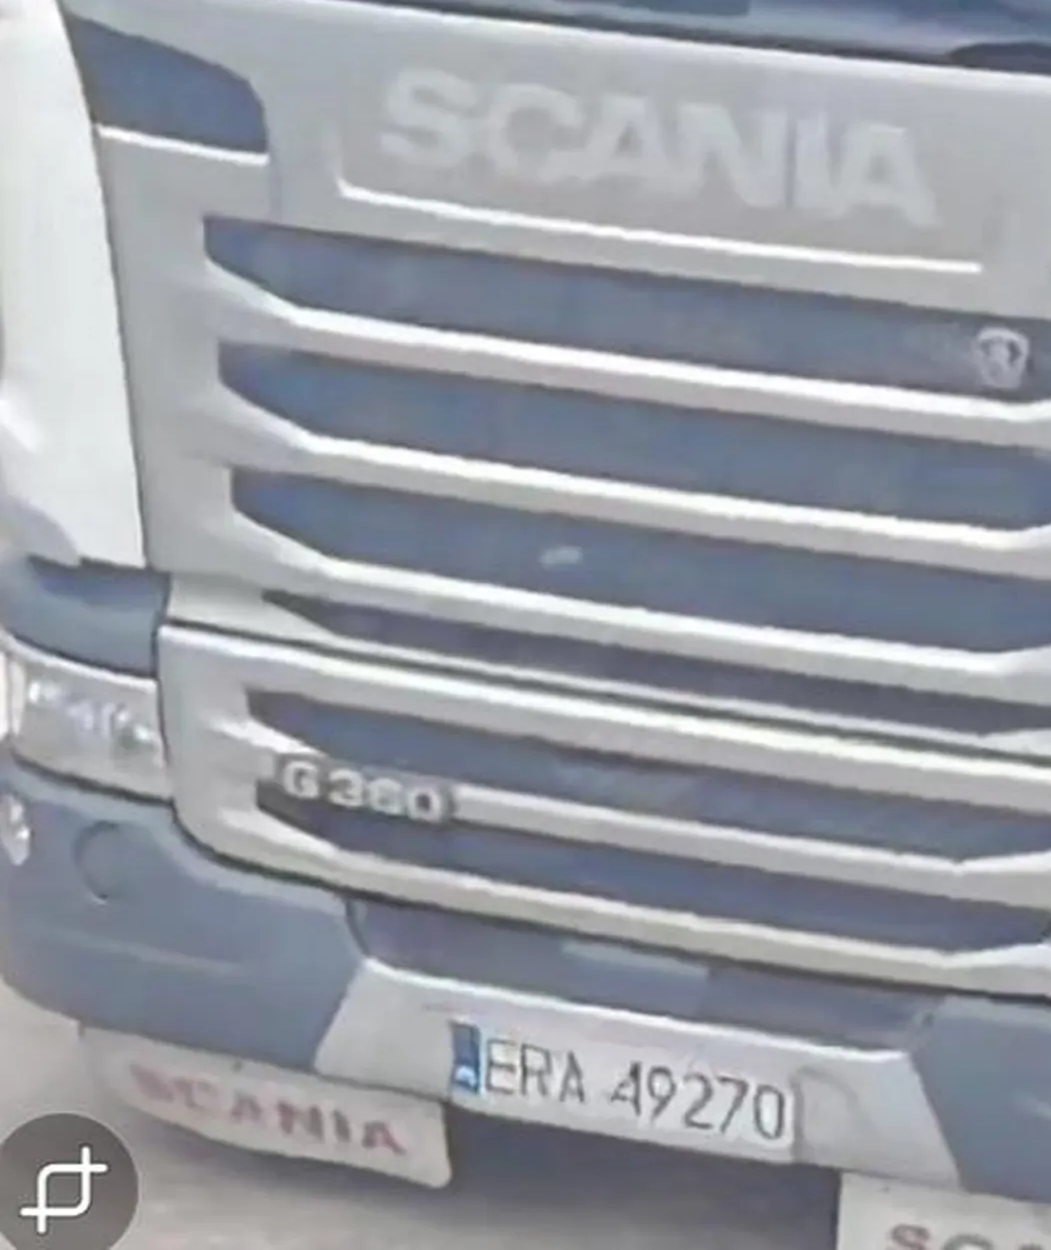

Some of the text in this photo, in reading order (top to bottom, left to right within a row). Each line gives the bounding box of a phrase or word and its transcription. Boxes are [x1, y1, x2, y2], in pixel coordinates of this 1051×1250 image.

[379, 70, 937, 227] SCANIA
[484, 1037, 787, 1141] ERA 49270
